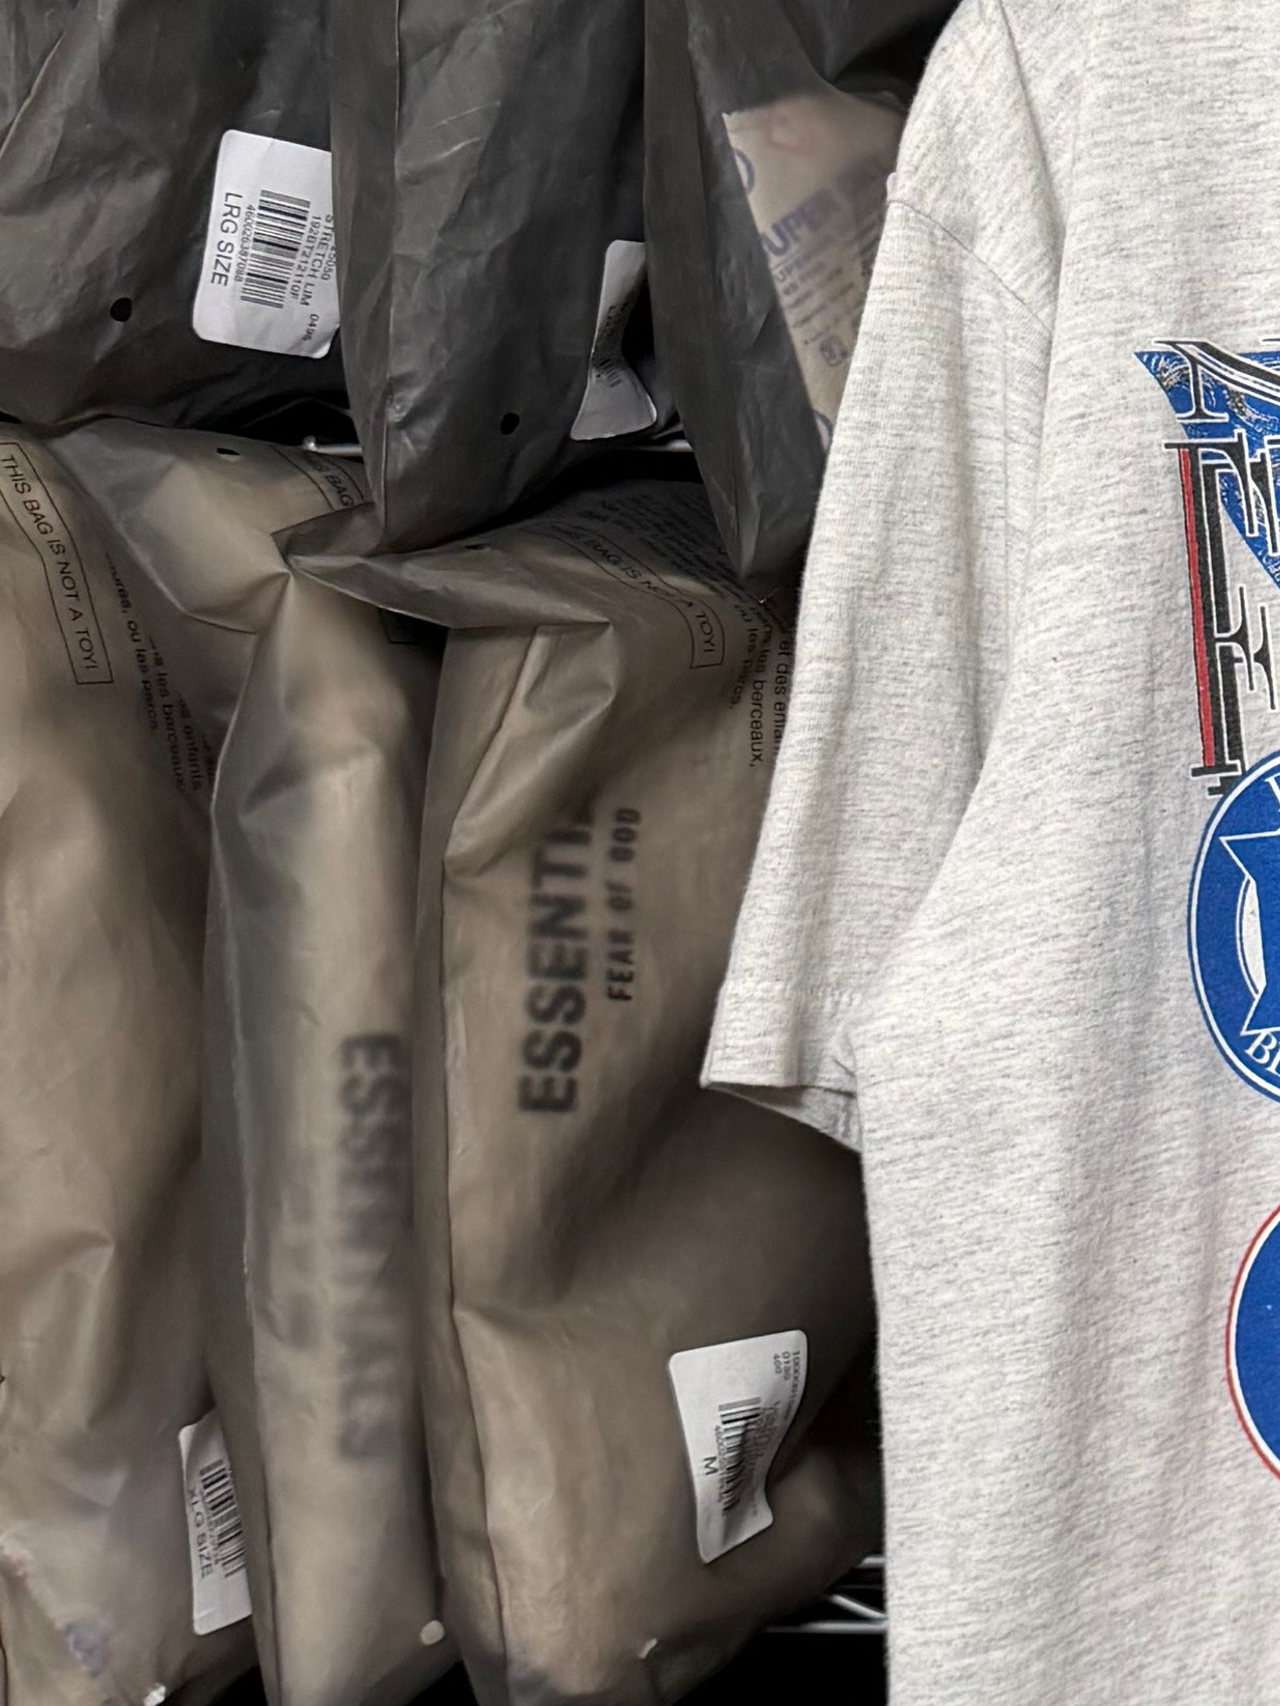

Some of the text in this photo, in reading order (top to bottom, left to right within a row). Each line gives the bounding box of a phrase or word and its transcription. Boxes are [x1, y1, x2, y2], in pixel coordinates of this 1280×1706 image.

[210, 191, 243, 287] LRG SIZE
[1, 453, 32, 495] THIS
[22, 495, 54, 535] BAG
[47, 538, 66, 555] IS
[57, 561, 81, 602] NOT
[68, 607, 84, 622] A
[703, 1456, 719, 1476] M
